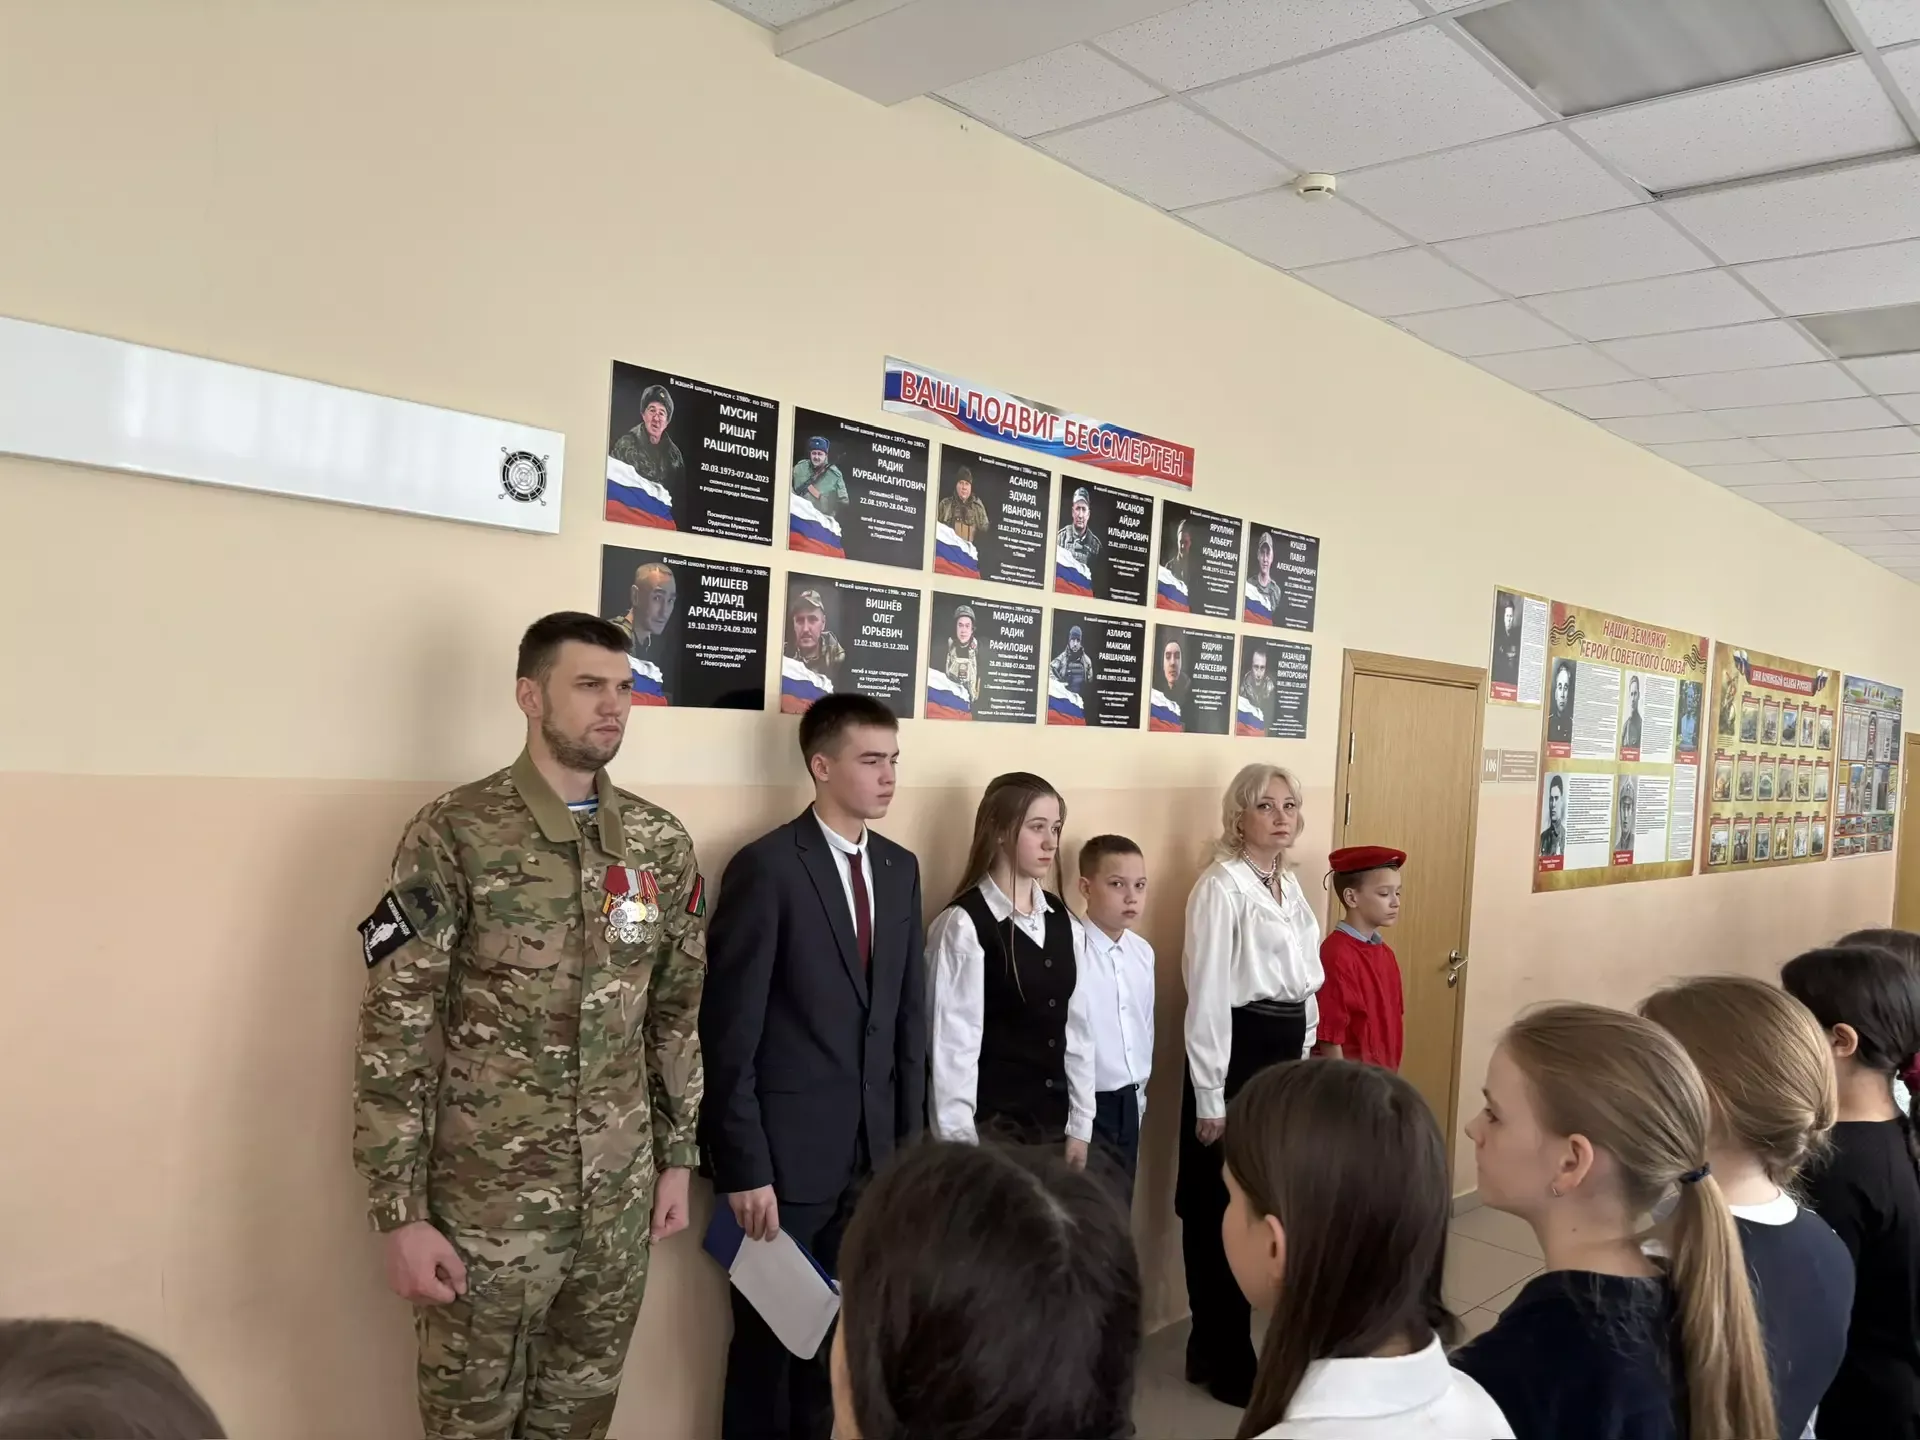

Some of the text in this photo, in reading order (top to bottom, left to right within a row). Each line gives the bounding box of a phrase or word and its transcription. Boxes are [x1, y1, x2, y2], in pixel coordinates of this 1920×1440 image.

[719, 403, 757, 423] МУСИН
[719, 422, 756, 441] РИШАТ
[901, 370, 1184, 477] ВАШ ПОДВИГ БЕССМЕРТЕН
[703, 437, 769, 461] РАШИТОВИЧ
[871, 442, 910, 460] КАРИМОВ
[700, 462, 769, 484] 20.03.1973-07.04.2023
[877, 458, 903, 474] РАДИК
[852, 467, 925, 492] КУРБАНСАГИТОВИЧ
[1009, 475, 1038, 490] АСАНОВ
[1008, 489, 1036, 506] ЭДУАРД
[1002, 503, 1041, 520] ИВАНОВИЧ
[1116, 500, 1144, 515] ХАСАНОВ
[1118, 513, 1140, 529] АЙДАР
[1107, 526, 1148, 544] ИЛЬДАРОВИЧ
[668, 557, 686, 566] нашей
[706, 563, 724, 572] учился
[701, 575, 748, 591] МИШЕЕВ
[703, 591, 744, 608] ЭДУАРД
[865, 596, 902, 612] ВИШНЁВ
[687, 605, 757, 625] АРКАДЬЕВИЧ
[872, 612, 894, 624] ОЛЕГ
[992, 611, 1033, 626] МАРДАНОВ
[687, 621, 756, 635] 19.10.1973-24.09.2024
[861, 625, 902, 639] ЮРЬЕВИЧ
[1000, 626, 1024, 639] РАДИК
[1106, 628, 1131, 639] АЗЛАРОВ
[1603, 620, 1630, 639] НАШИ
[1630, 628, 1667, 649] ЗЕМЛЯКИ
[719, 646, 756, 655] спецоперации
[989, 640, 1033, 653] РАФИЛОВИЧ
[1105, 641, 1130, 651] МАКСИМ
[703, 653, 733, 661] территории
[1580, 640, 1687, 675] ГЕРОИ СОВЕТСКОГО СОЮЗА
[1485, 758, 1497, 772] 106
